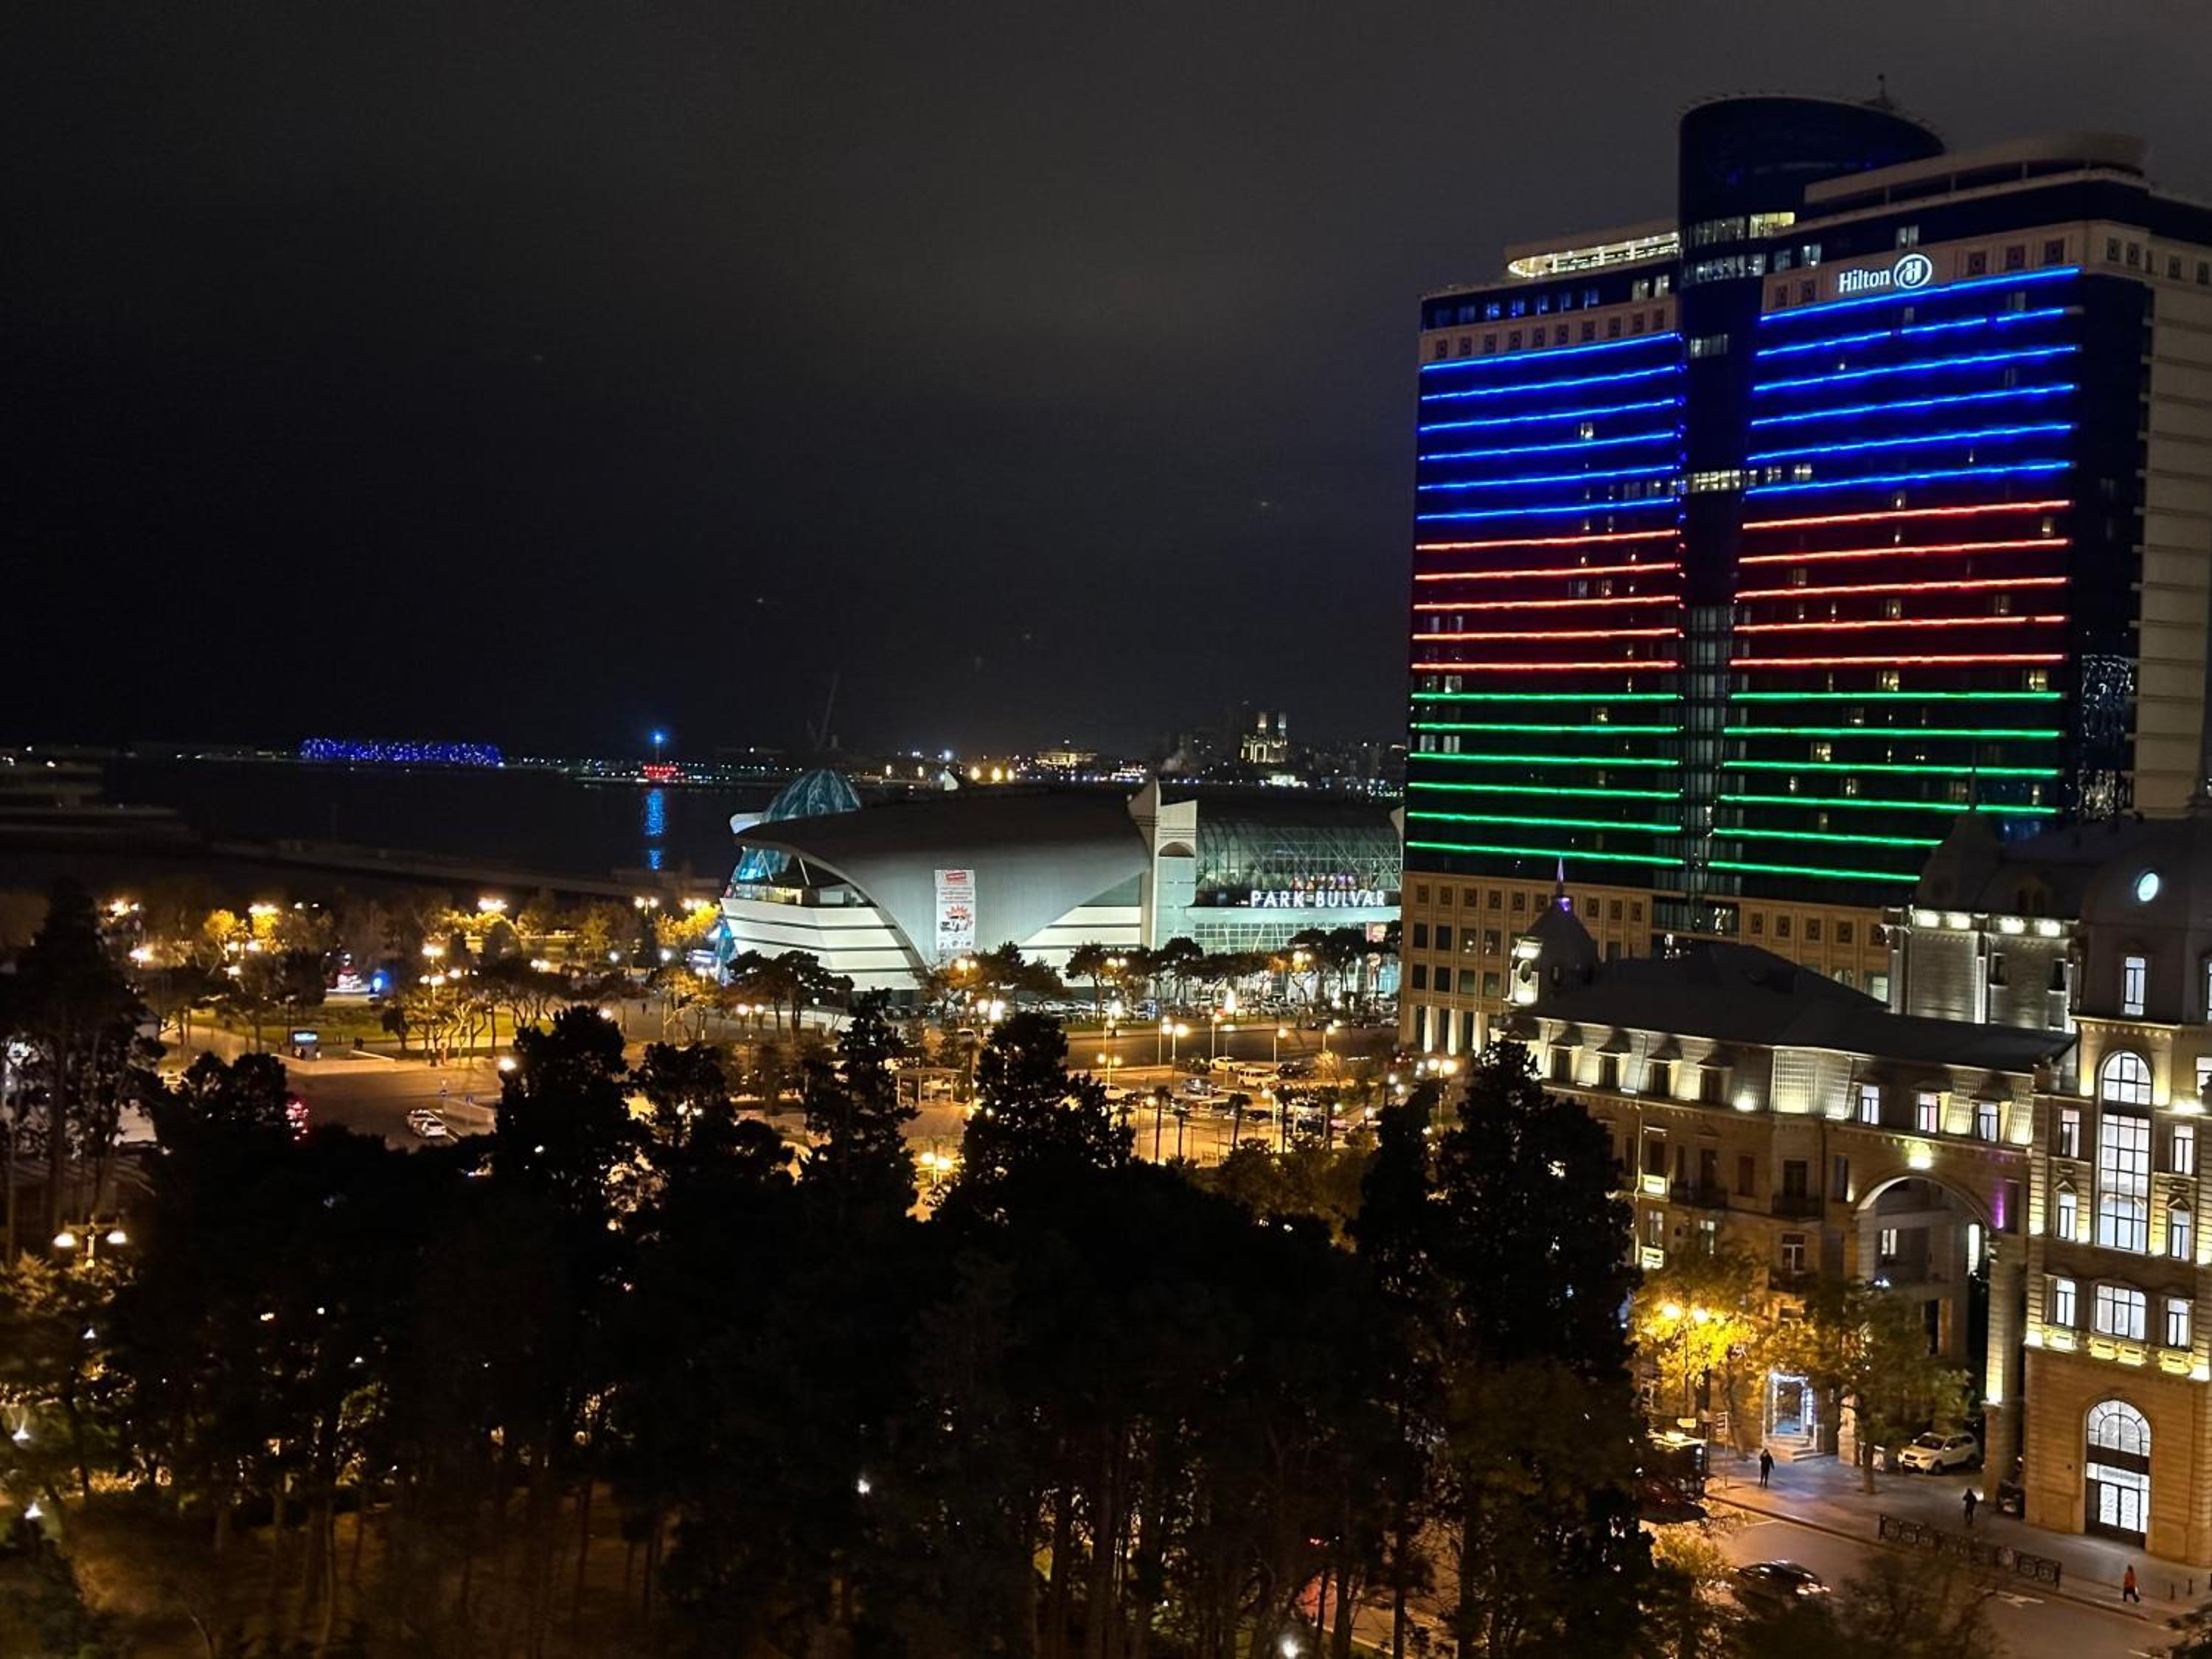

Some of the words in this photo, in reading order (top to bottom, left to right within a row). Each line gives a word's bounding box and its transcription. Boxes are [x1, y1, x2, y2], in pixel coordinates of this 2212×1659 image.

[1839, 269, 1891, 293] Hilton
[1251, 890, 1305, 908] PARK
[1315, 890, 1385, 907] BULVAR
